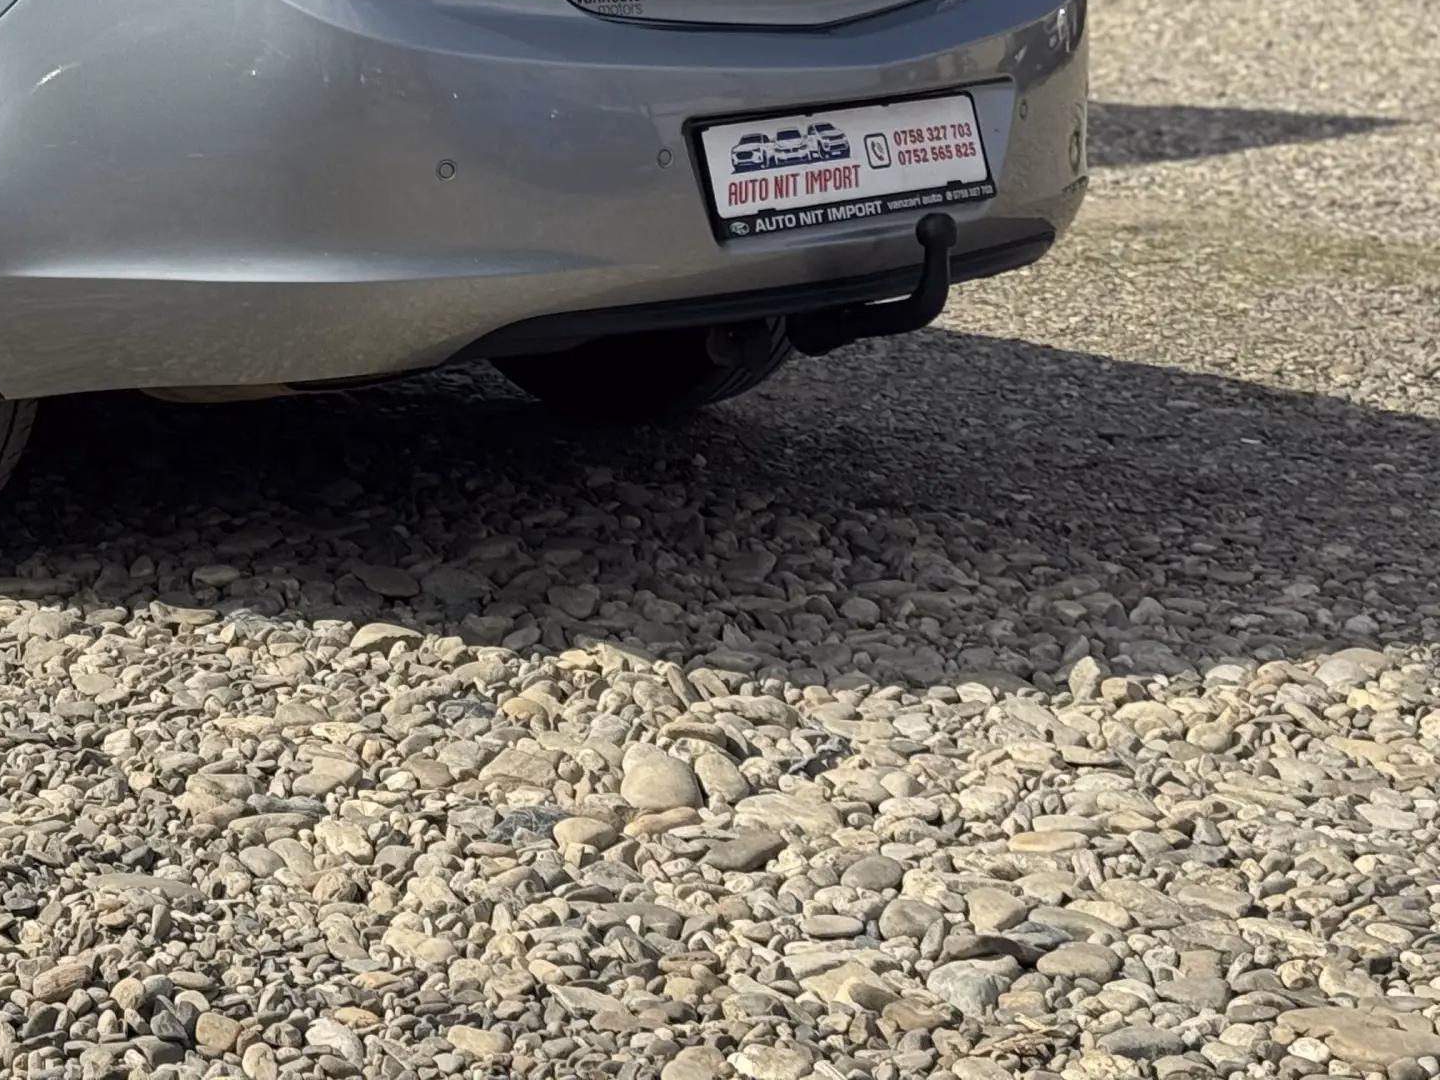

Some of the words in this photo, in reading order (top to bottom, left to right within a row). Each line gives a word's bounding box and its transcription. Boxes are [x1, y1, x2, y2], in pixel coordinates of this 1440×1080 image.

[597, 2, 643, 17] motors
[893, 128, 925, 146] 0758
[926, 125, 947, 142] 327
[949, 122, 972, 139] 703
[898, 147, 929, 166] 0752
[930, 144, 953, 162] 565
[954, 141, 977, 158] 825
[728, 178, 769, 206] AUTO
[774, 173, 800, 200] NIT
[805, 164, 861, 195] IMPORT
[755, 214, 796, 233] AUTO
[799, 209, 824, 226] NIT
[827, 201, 883, 222] IMPORT
